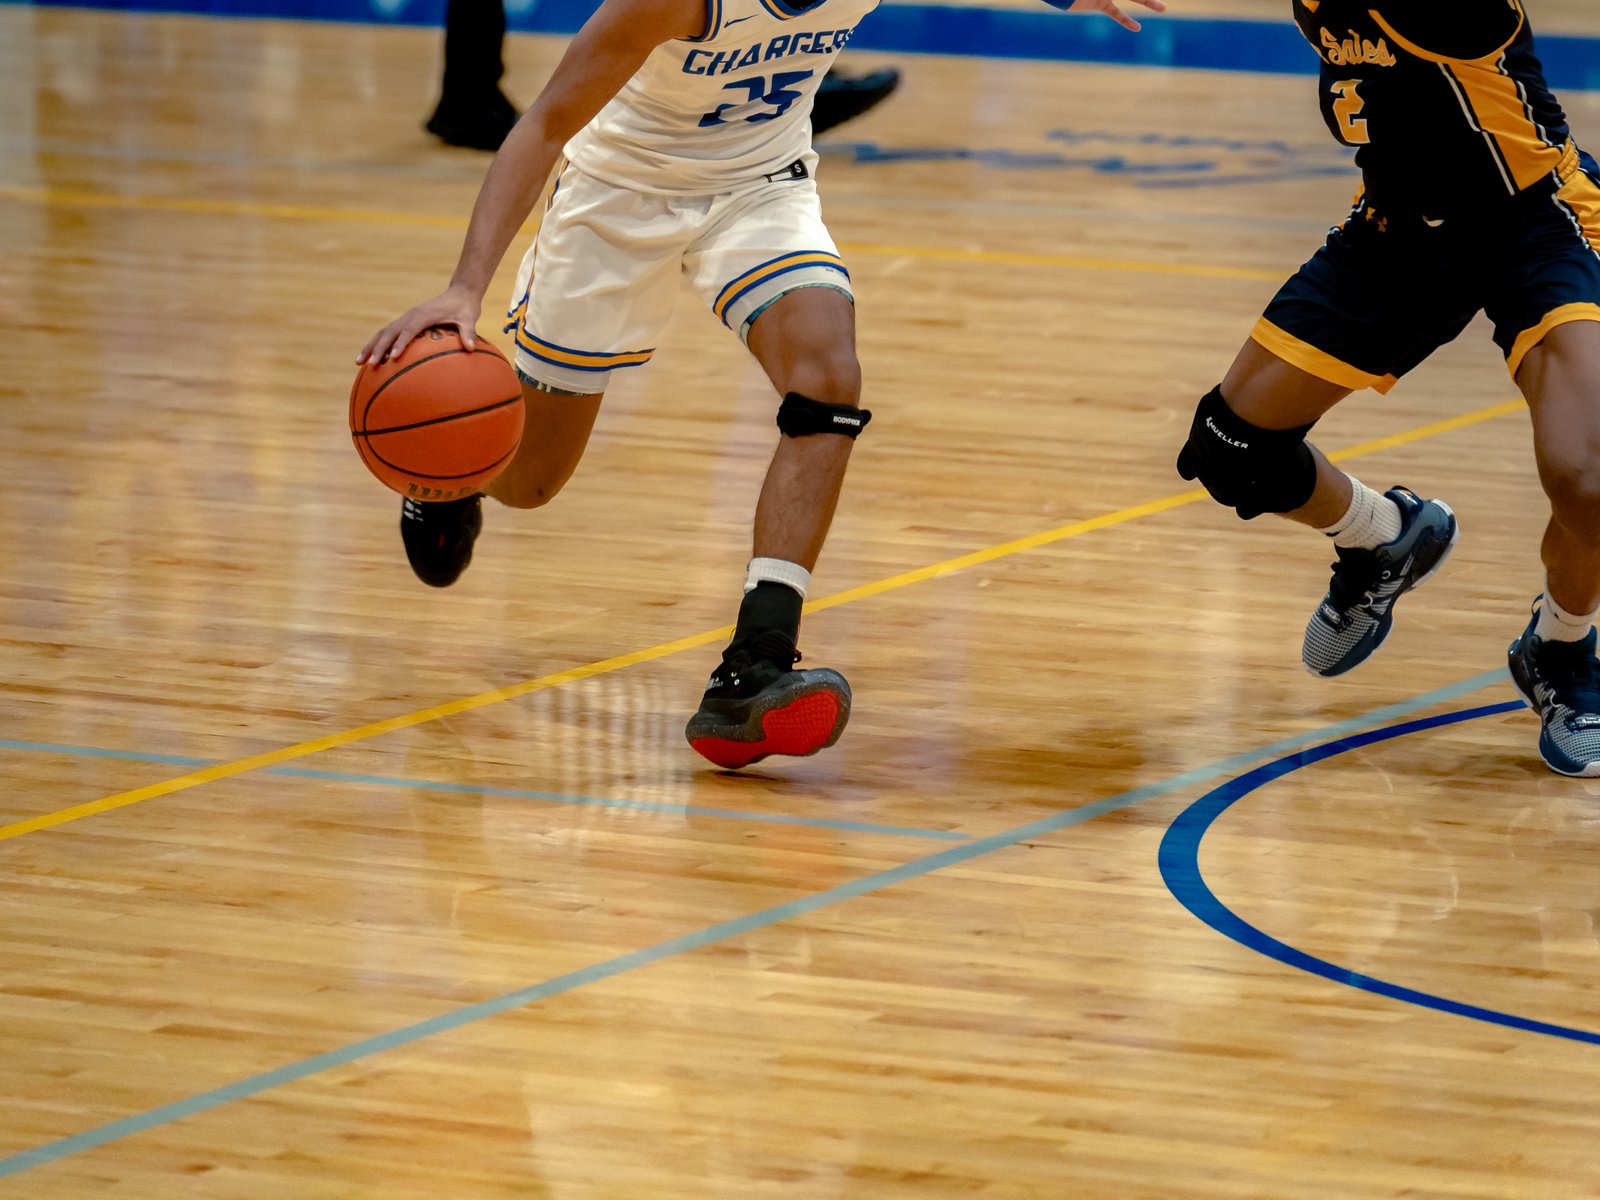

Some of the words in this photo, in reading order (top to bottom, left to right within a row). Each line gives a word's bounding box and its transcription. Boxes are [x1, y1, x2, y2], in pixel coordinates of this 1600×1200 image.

[1319, 26, 1397, 67] Sales
[698, 69, 814, 127] 25
[1330, 78, 1371, 144] 2
[1208, 421, 1249, 449] MUELLER
